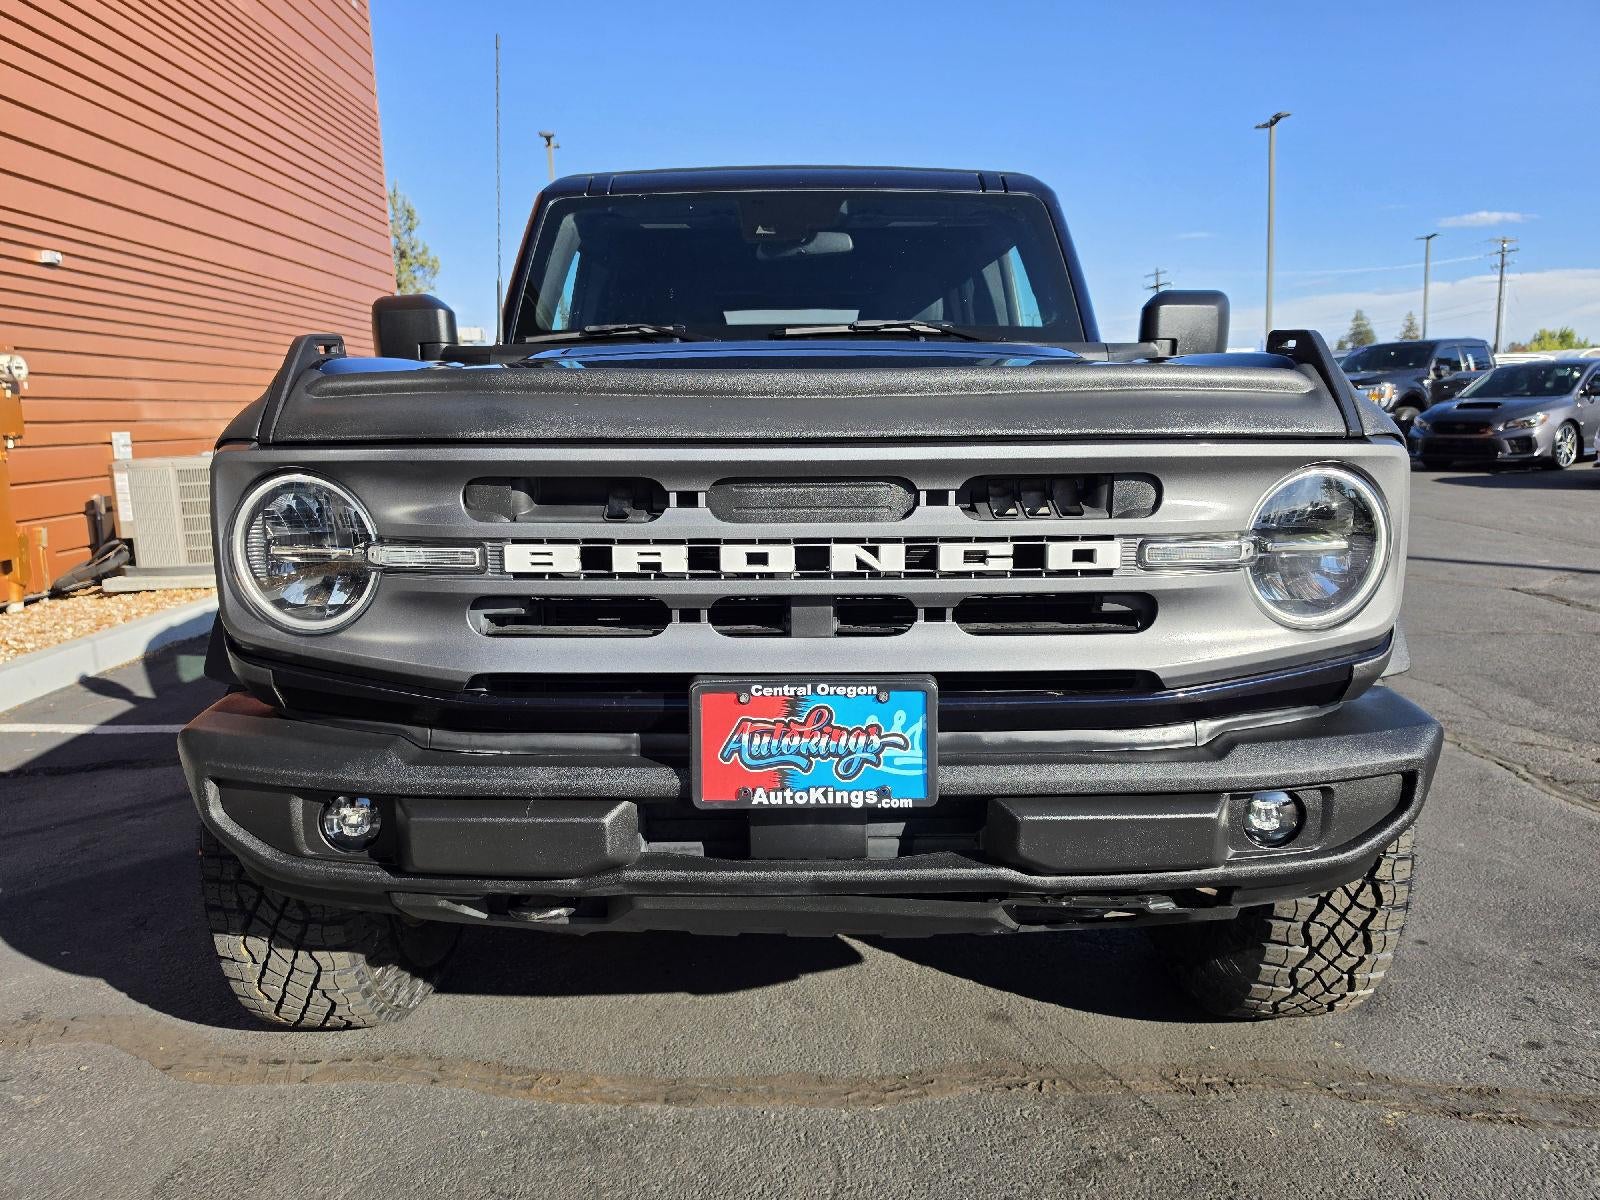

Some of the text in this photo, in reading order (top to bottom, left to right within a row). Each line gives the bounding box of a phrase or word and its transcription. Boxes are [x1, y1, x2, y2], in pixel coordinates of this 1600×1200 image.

[504, 542, 1121, 573] BRONCO
[750, 683, 878, 698] Central Oregon
